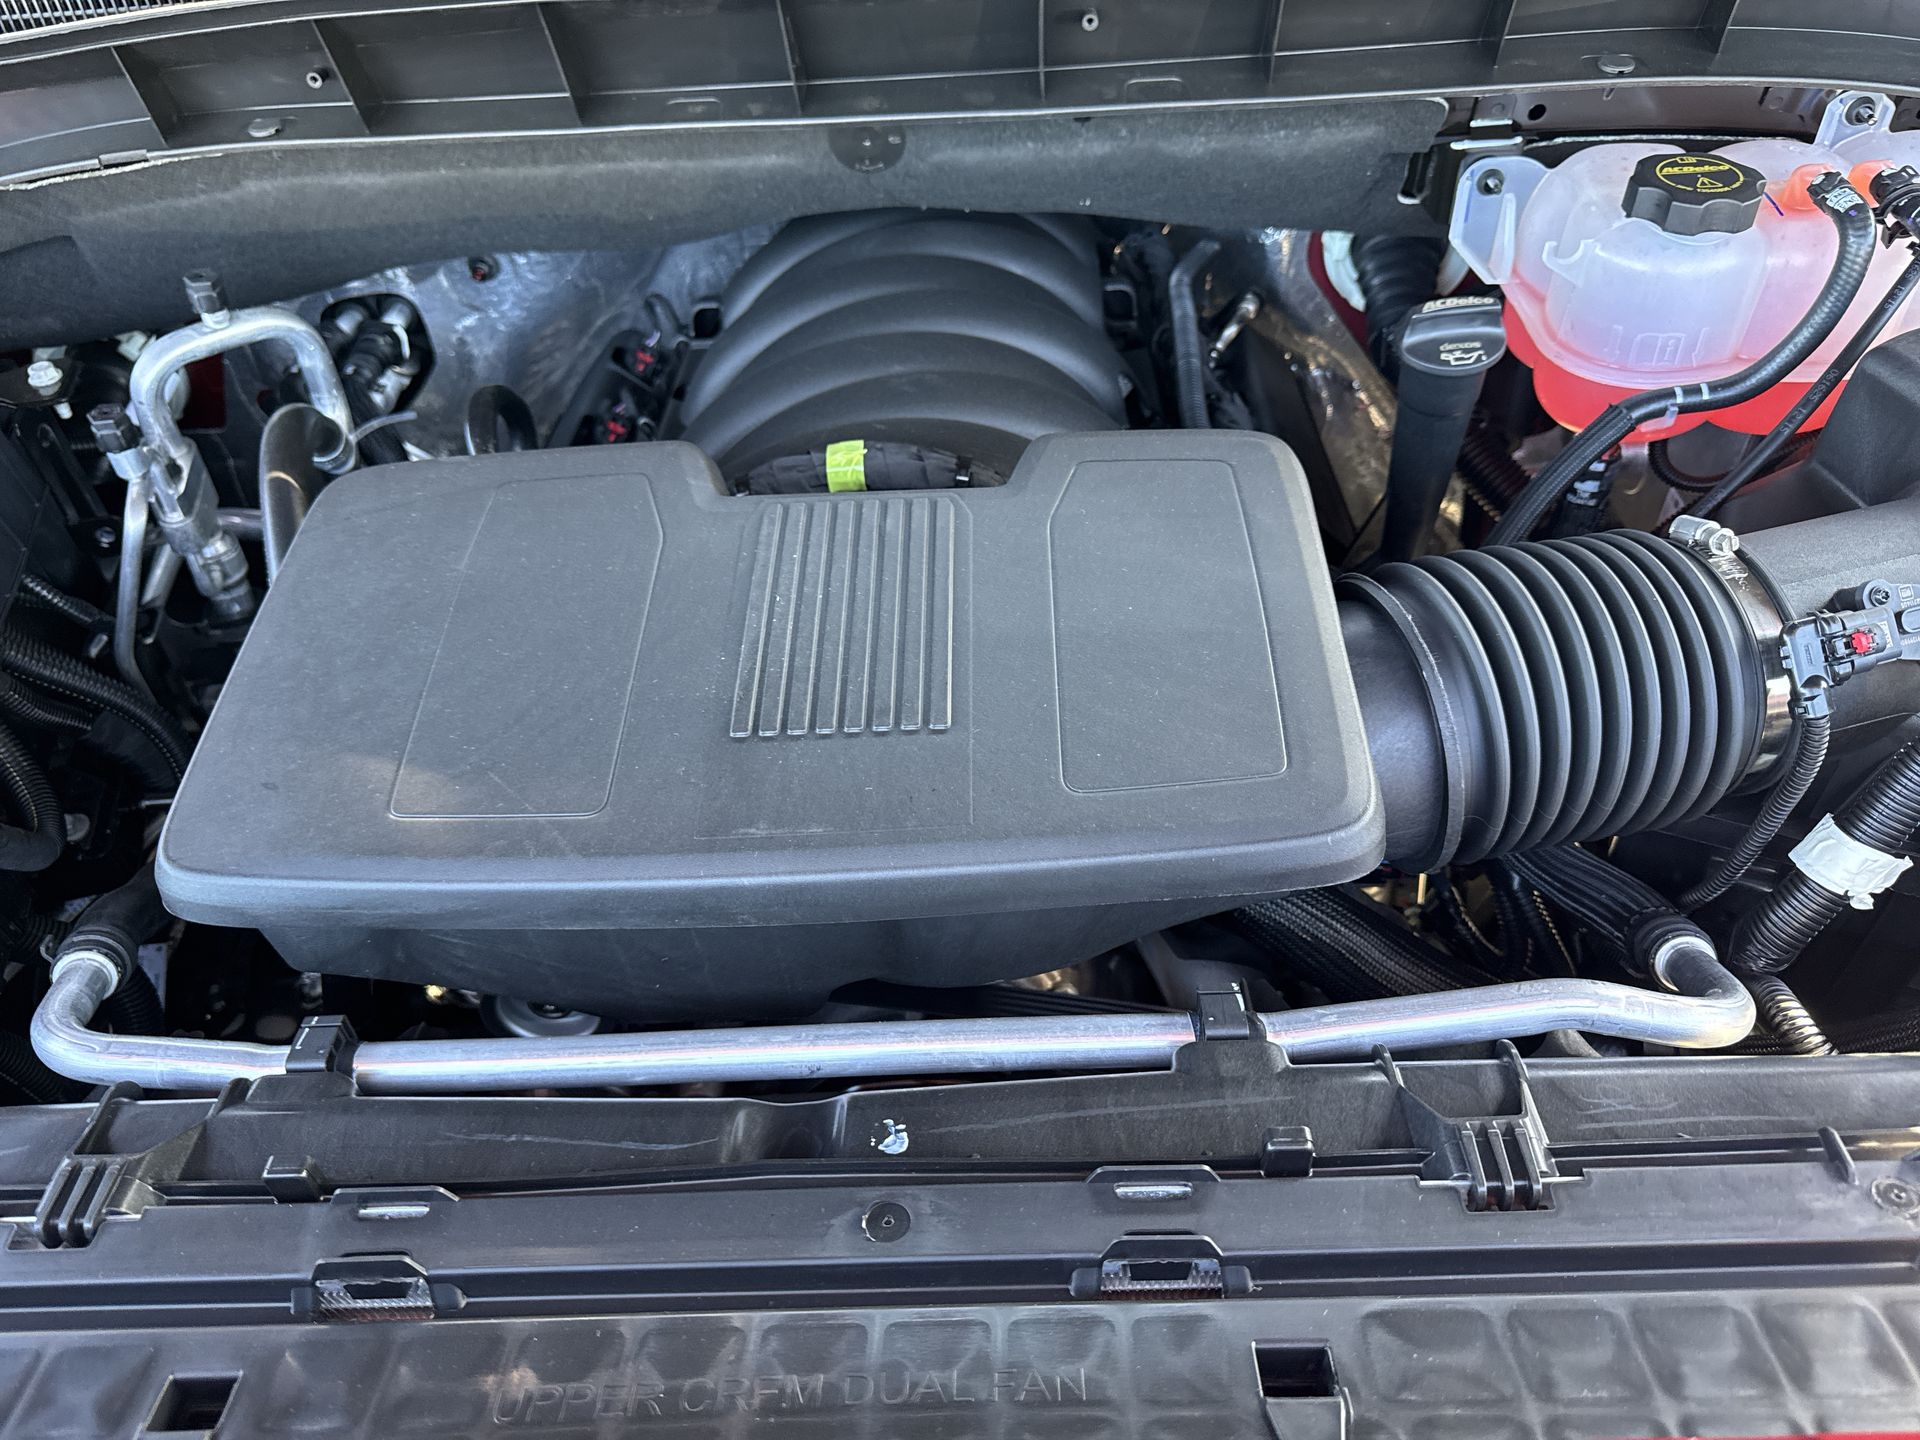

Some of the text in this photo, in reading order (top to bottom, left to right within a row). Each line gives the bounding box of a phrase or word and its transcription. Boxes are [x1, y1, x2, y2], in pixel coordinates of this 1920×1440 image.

[1660, 165, 1730, 175] ACDelco
[1422, 296, 1494, 313] ACDelco
[492, 1383, 664, 1424] UPPER
[843, 1369, 975, 1404] DUAL
[993, 1368, 1087, 1401] FAN
